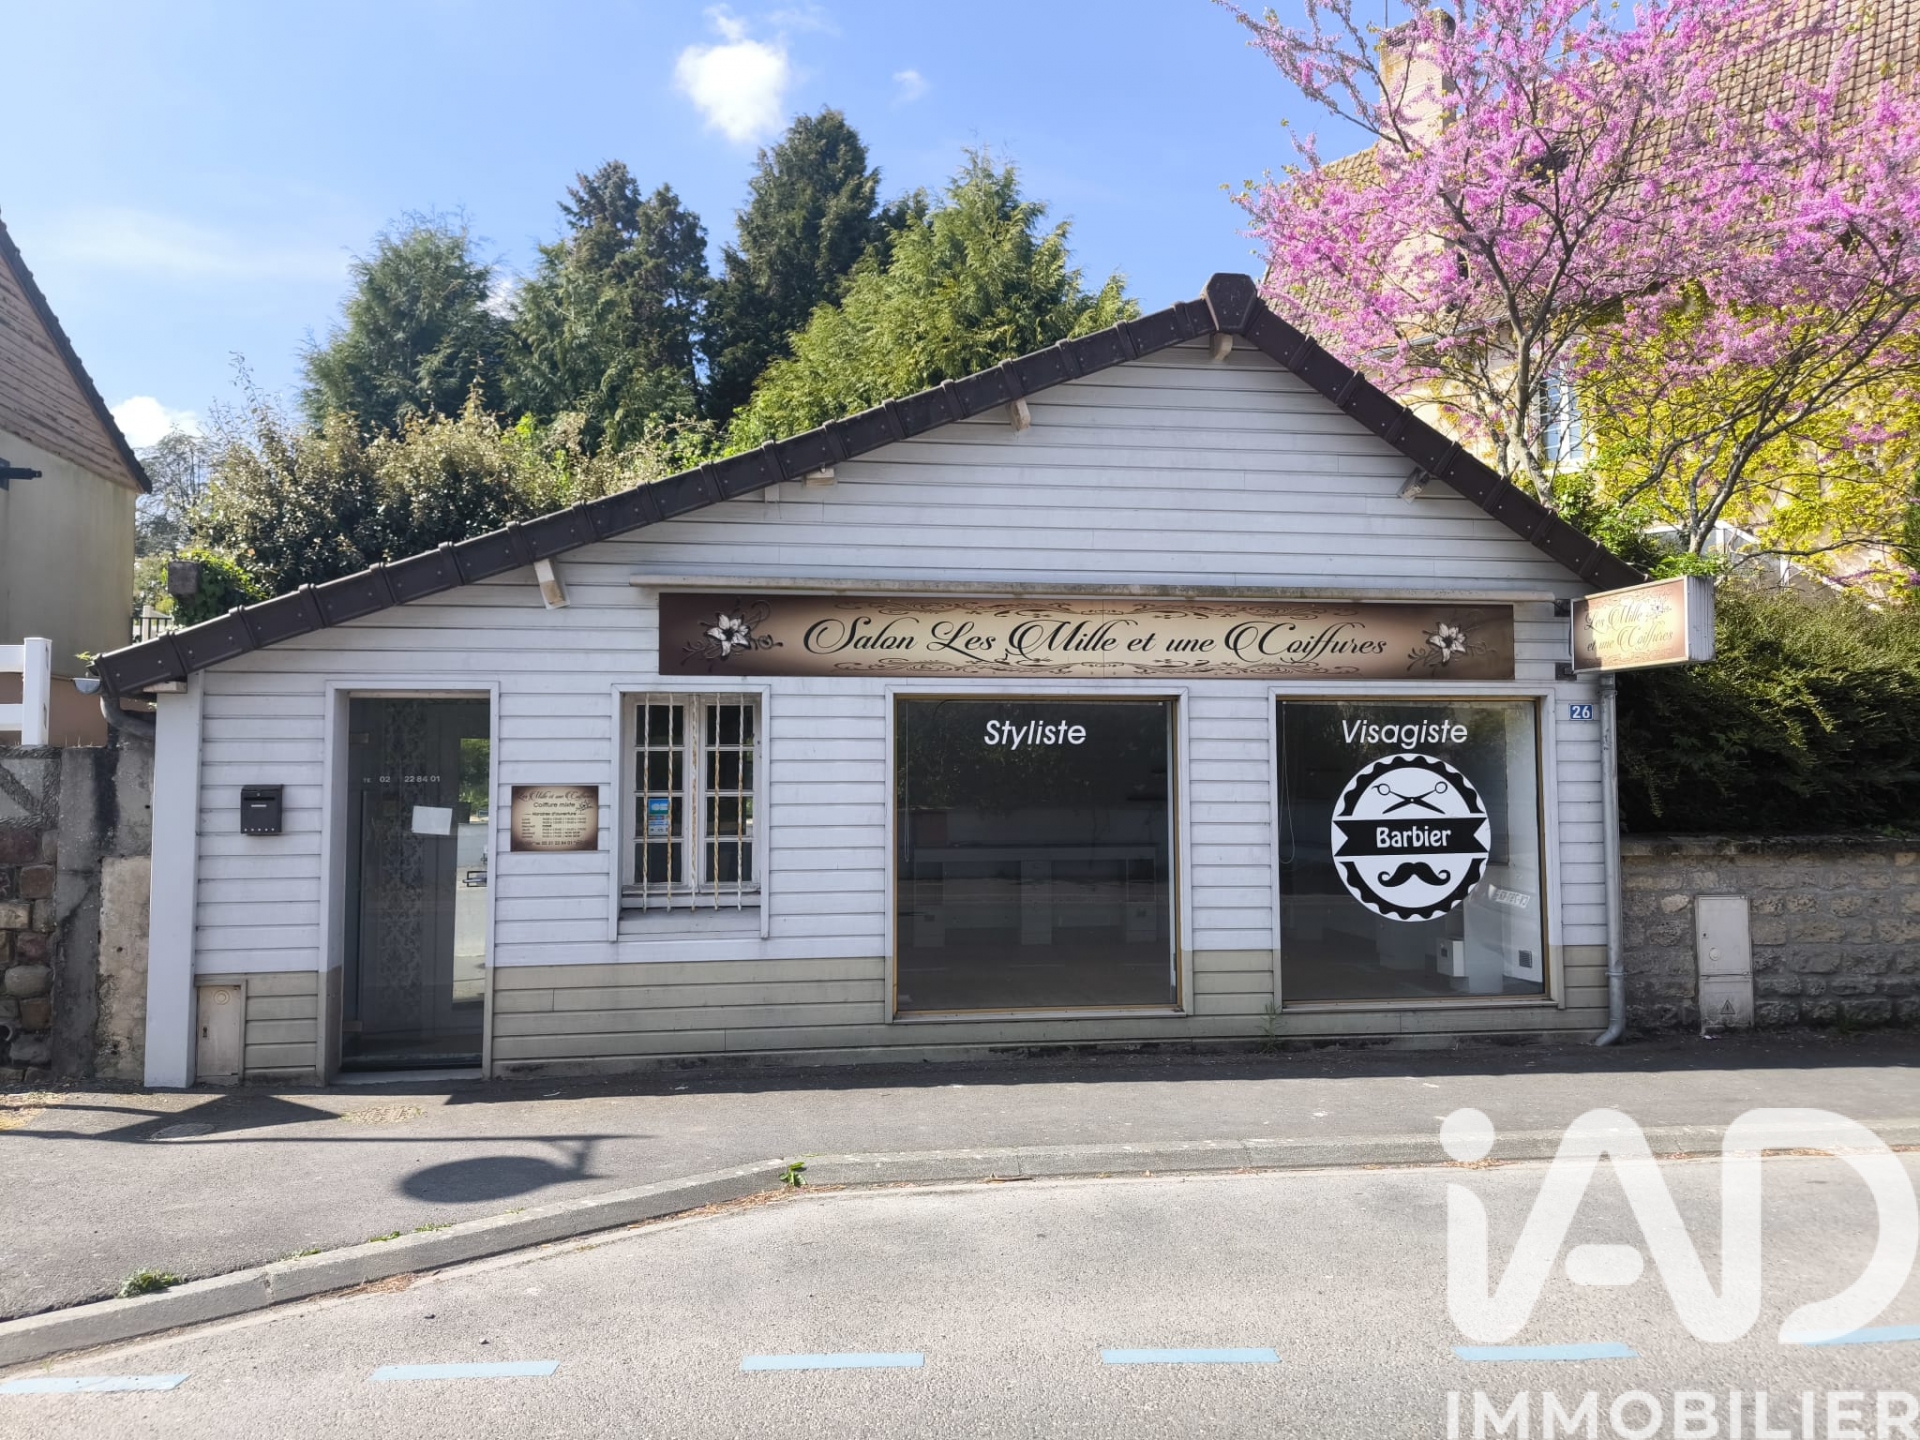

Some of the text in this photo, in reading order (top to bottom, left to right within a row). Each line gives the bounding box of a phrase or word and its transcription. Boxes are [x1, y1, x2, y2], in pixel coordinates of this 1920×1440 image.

[1584, 600, 1643, 634] Les Mille
[803, 616, 1387, 664] Salon Les Mille et une Coiffures
[1587, 641, 1597, 652] et
[1617, 619, 1673, 652] Coiffures
[1572, 705, 1591, 719] 26
[984, 719, 1087, 751] Styliste
[1342, 719, 1468, 750] Visagiste
[379, 775, 391, 783] 02
[404, 775, 415, 783] 22
[430, 774, 441, 783] 01
[1376, 825, 1452, 849] Barbier
